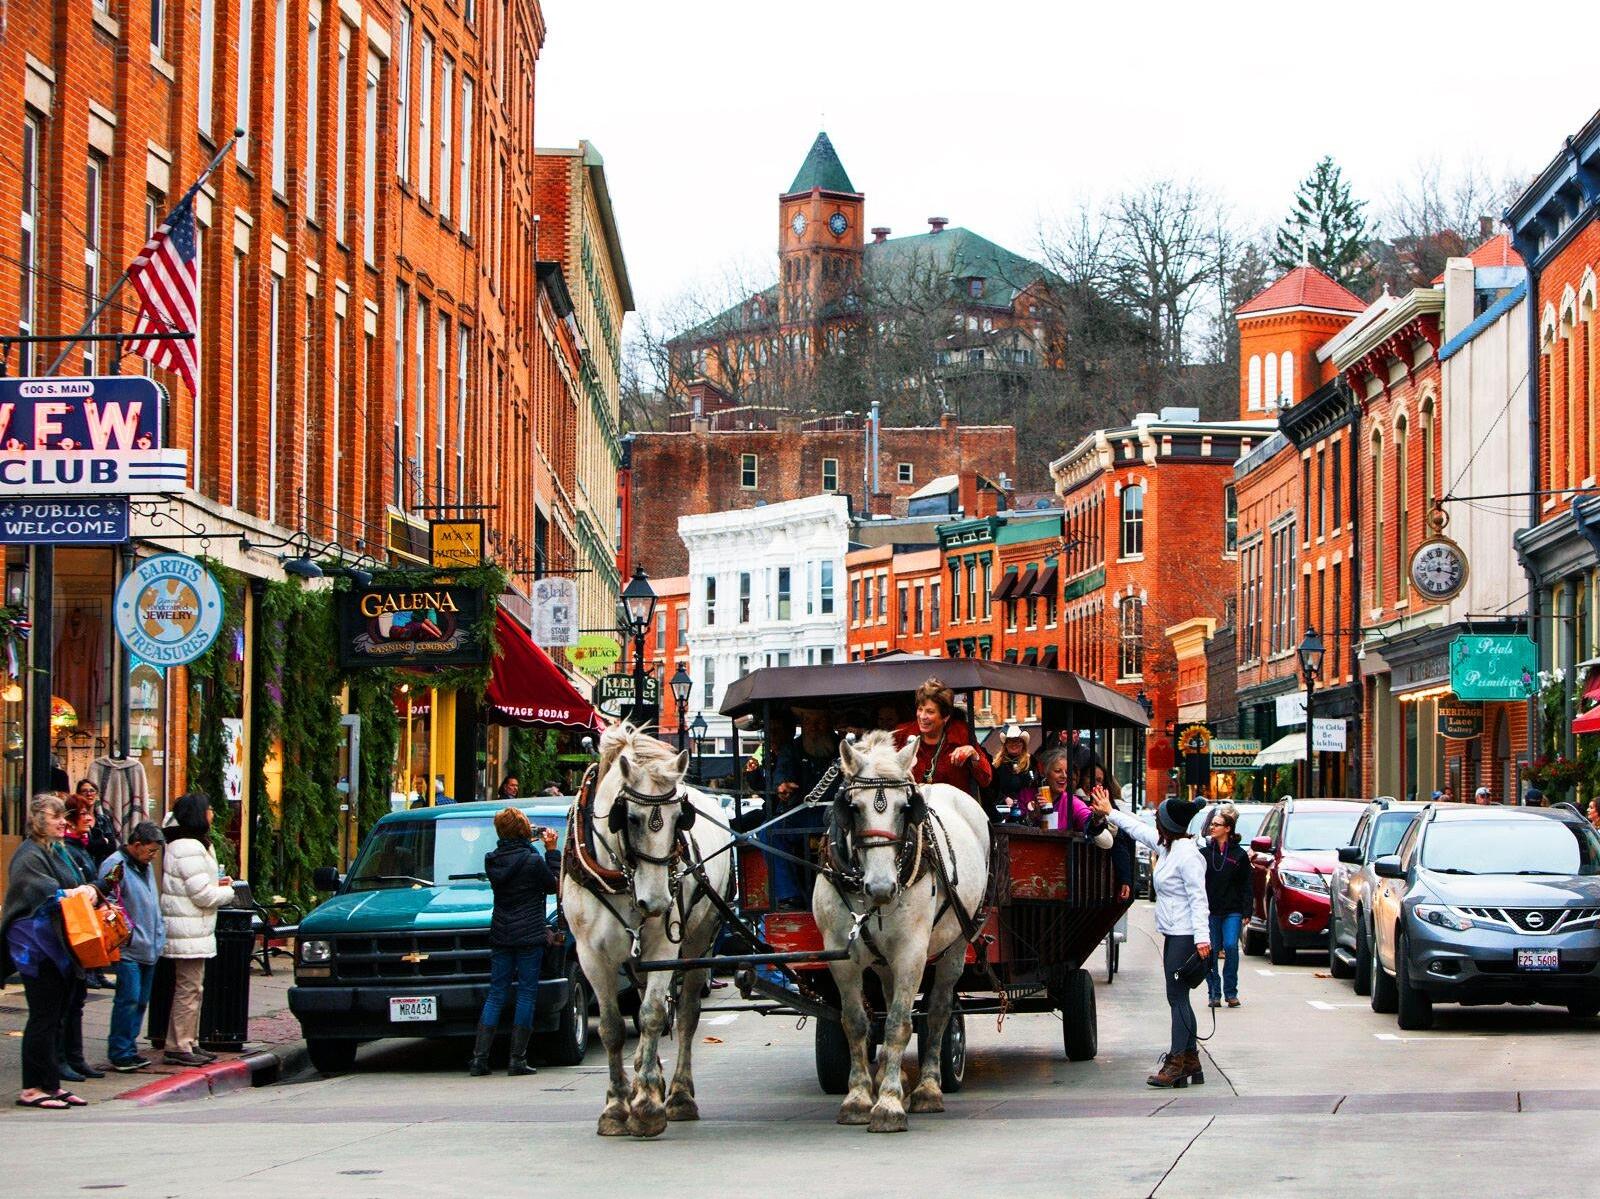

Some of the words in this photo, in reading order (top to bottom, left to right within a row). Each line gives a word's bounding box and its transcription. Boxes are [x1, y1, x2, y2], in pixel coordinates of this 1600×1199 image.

[24, 385, 43, 394] 100
[47, 385, 58, 394] S.
[61, 385, 90, 394] MAIN
[0, 459, 119, 485] CLUB
[21, 504, 102, 519] PUBLIC
[5, 521, 117, 535] WELCOME
[441, 532, 473, 541] MAX
[138, 559, 202, 582] EARTH'S
[360, 591, 460, 618] GALENA
[143, 610, 193, 620] JEWELRY
[126, 628, 209, 661] TREASURES
[1475, 637, 1513, 654] Petals
[602, 677, 656, 695] KLEI'S
[495, 705, 534, 717] NTAGE
[537, 708, 570, 719] SODAS
[1439, 707, 1482, 717] HERITAGE
[1537, 955, 1558, 966] 5608
